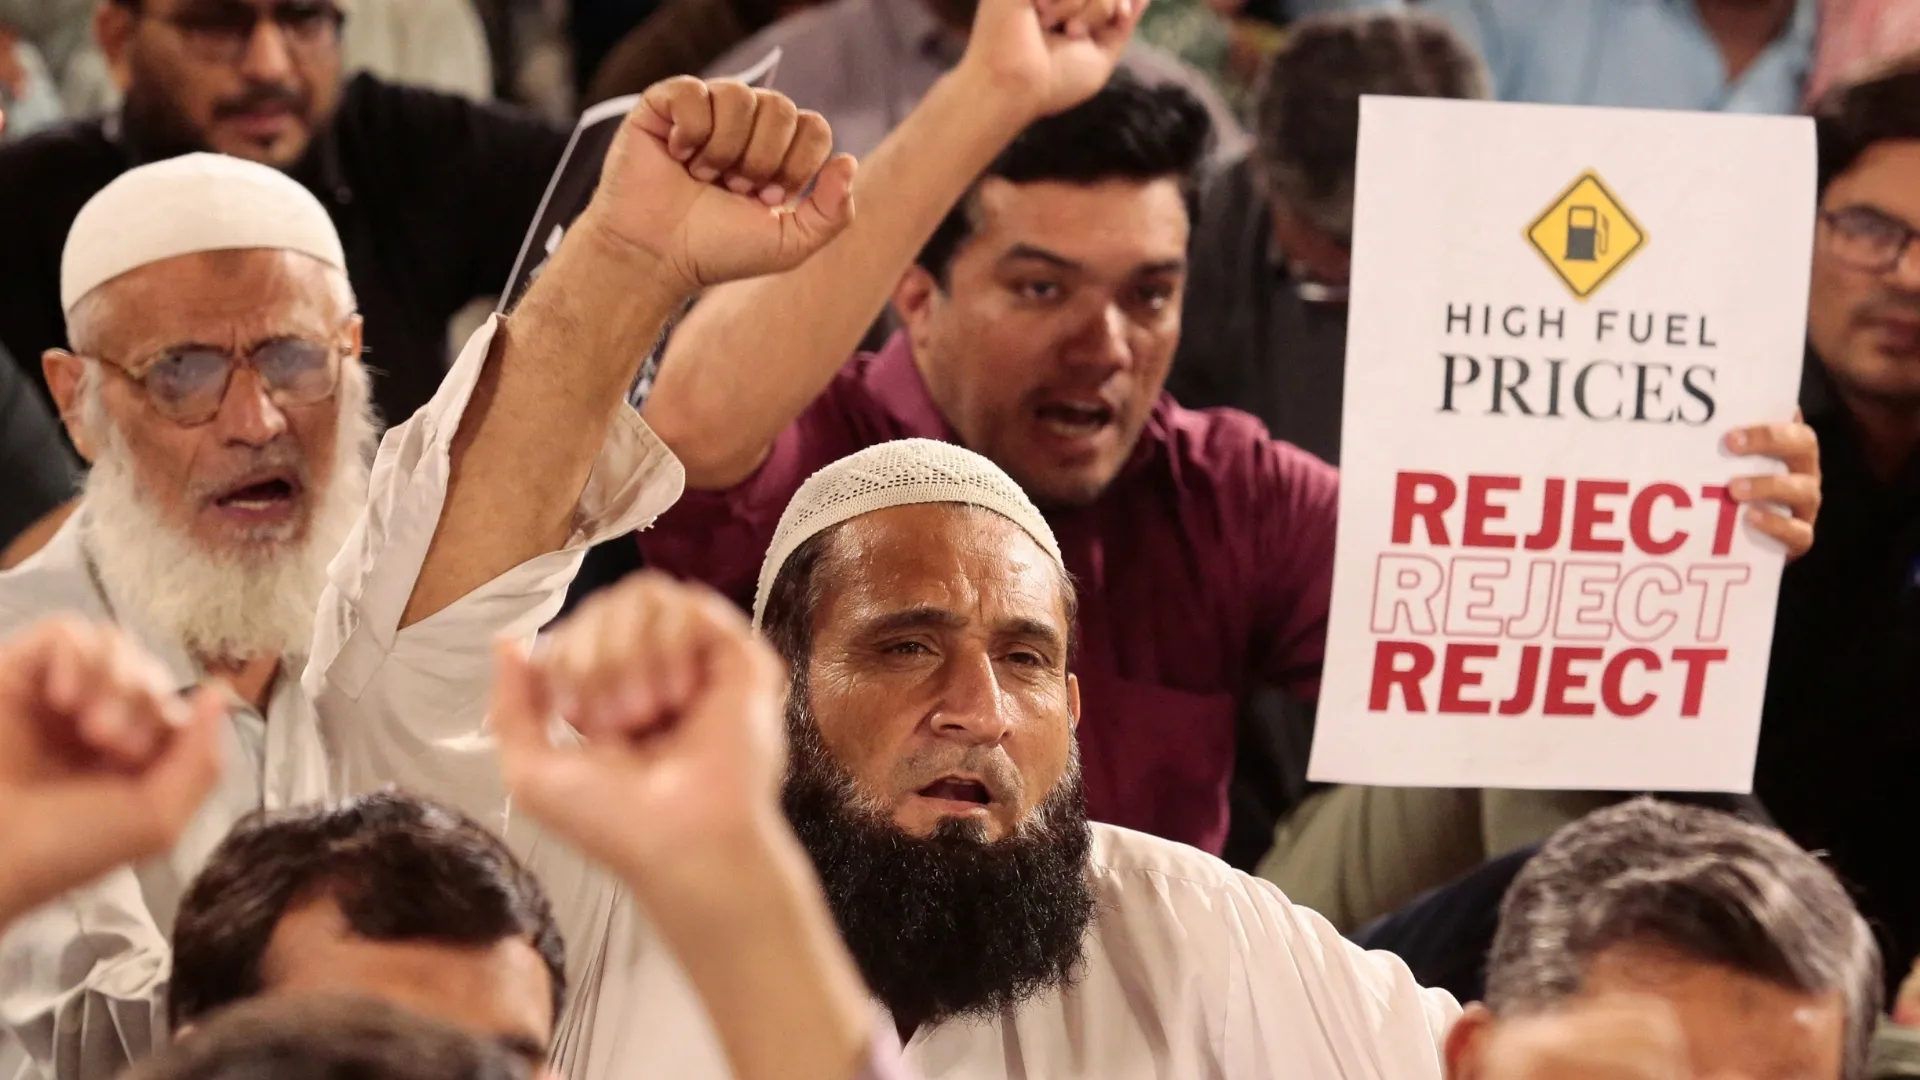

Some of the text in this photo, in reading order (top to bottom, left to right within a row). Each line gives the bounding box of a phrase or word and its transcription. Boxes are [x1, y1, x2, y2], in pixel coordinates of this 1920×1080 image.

[1446, 304, 1717, 347] HIGH FUEL
[1437, 354, 1717, 424] PRICES
[1391, 471, 1740, 556] REJECT
[1370, 554, 1750, 641] REJECT
[1368, 642, 1728, 718] REJECT
